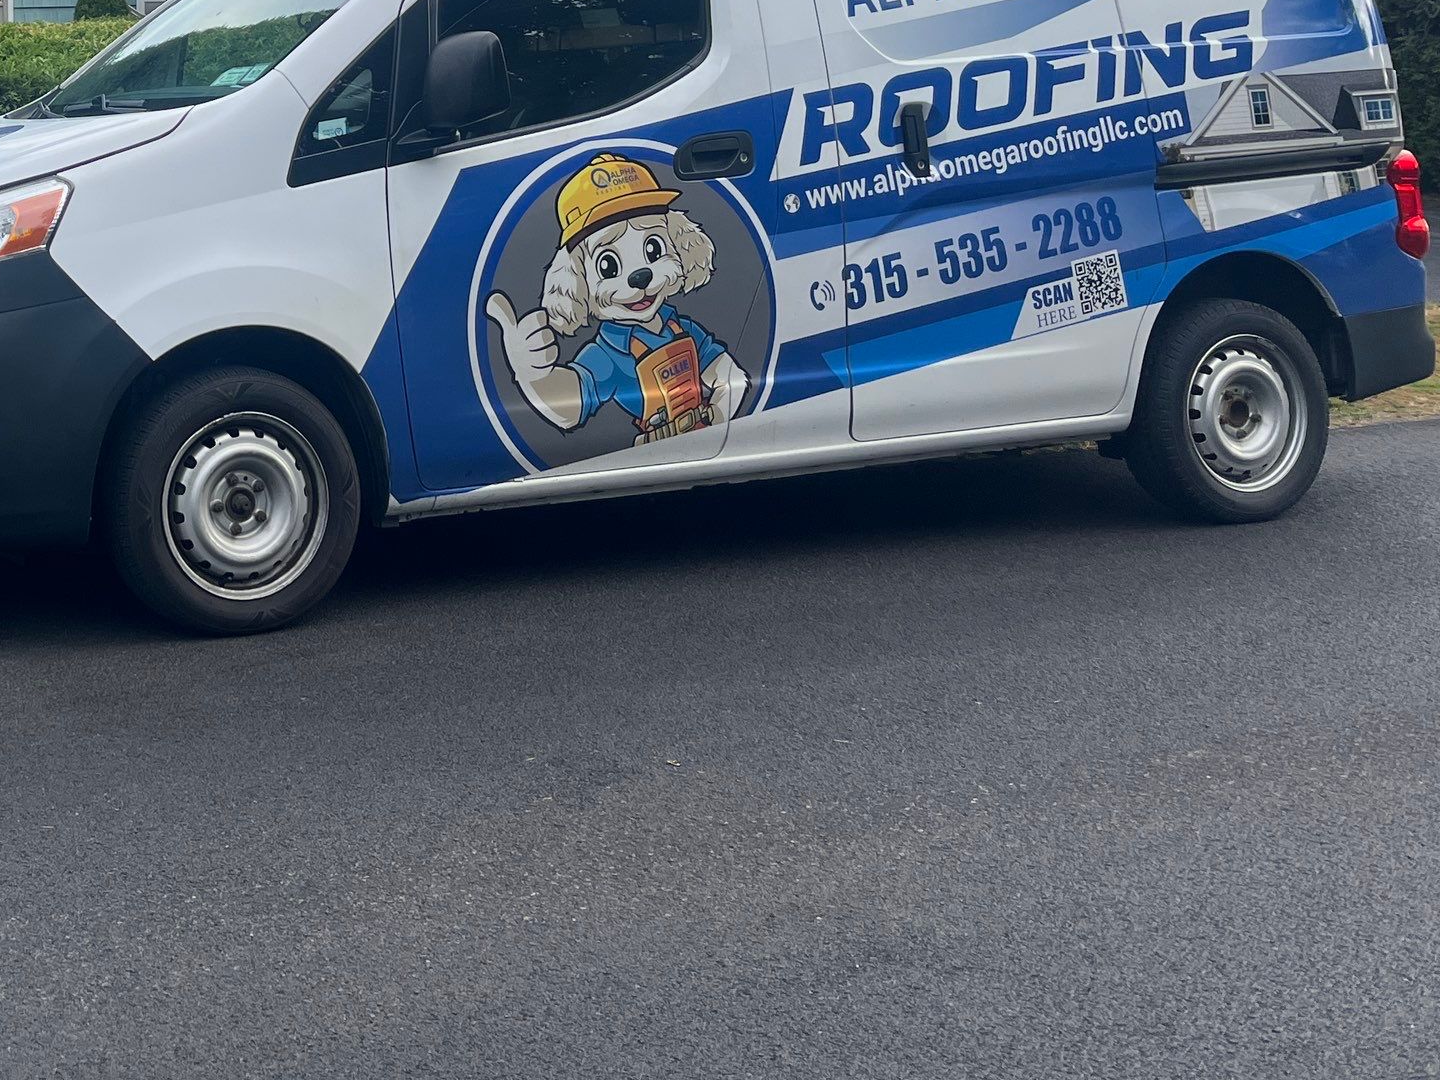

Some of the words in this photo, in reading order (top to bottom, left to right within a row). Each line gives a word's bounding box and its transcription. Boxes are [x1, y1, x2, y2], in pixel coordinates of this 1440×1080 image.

[799, 10, 1253, 167] ROOFING
[611, 166, 636, 178] ALPHA
[613, 175, 639, 185] OMEGA
[841, 251, 908, 310] 315
[934, 226, 1008, 284] 535
[1032, 196, 1123, 260] 2288
[1032, 281, 1074, 310] SCAN
[1037, 305, 1077, 328] HERE
[662, 360, 689, 379] OLLIE
